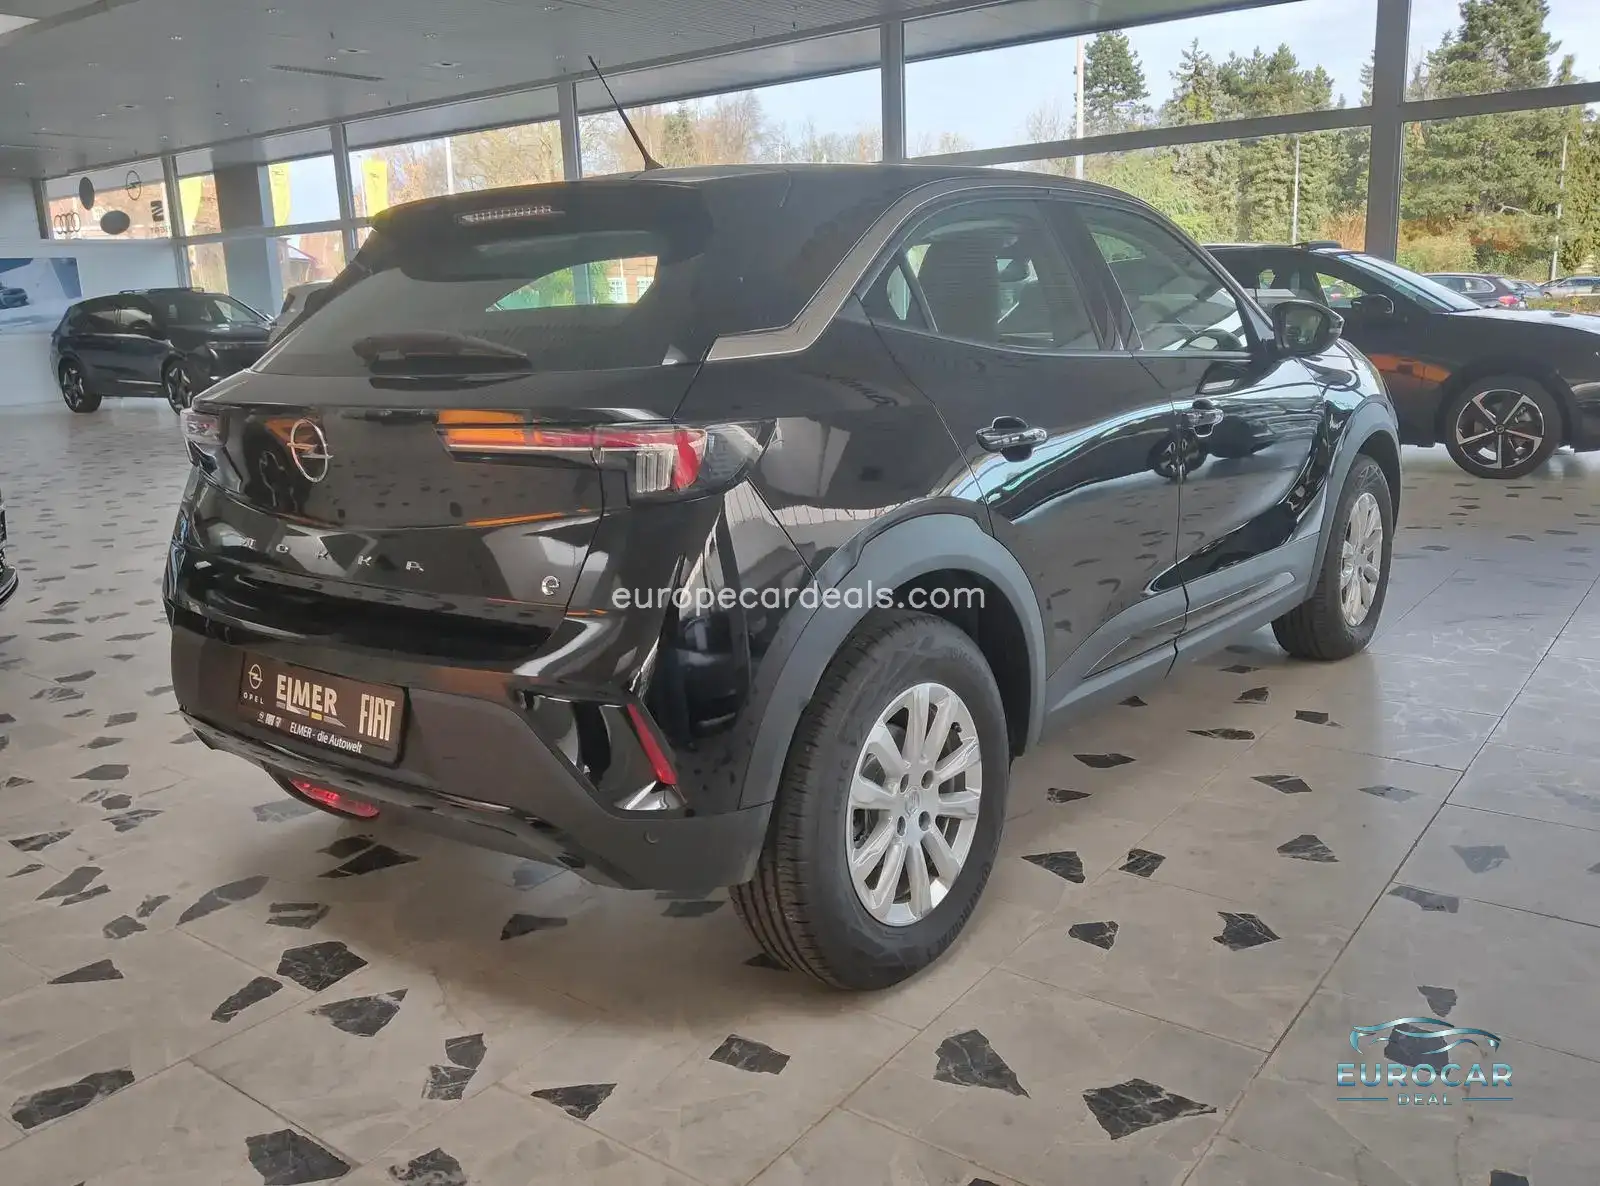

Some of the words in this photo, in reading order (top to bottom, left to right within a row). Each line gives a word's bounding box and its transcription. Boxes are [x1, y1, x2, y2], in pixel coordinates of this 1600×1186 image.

[541, 575, 560, 596] e
[243, 691, 265, 705] OPEL
[276, 674, 338, 717] ELMER
[358, 693, 395, 741] FIAT
[317, 730, 329, 744] die
[328, 734, 363, 754] Autowelt
